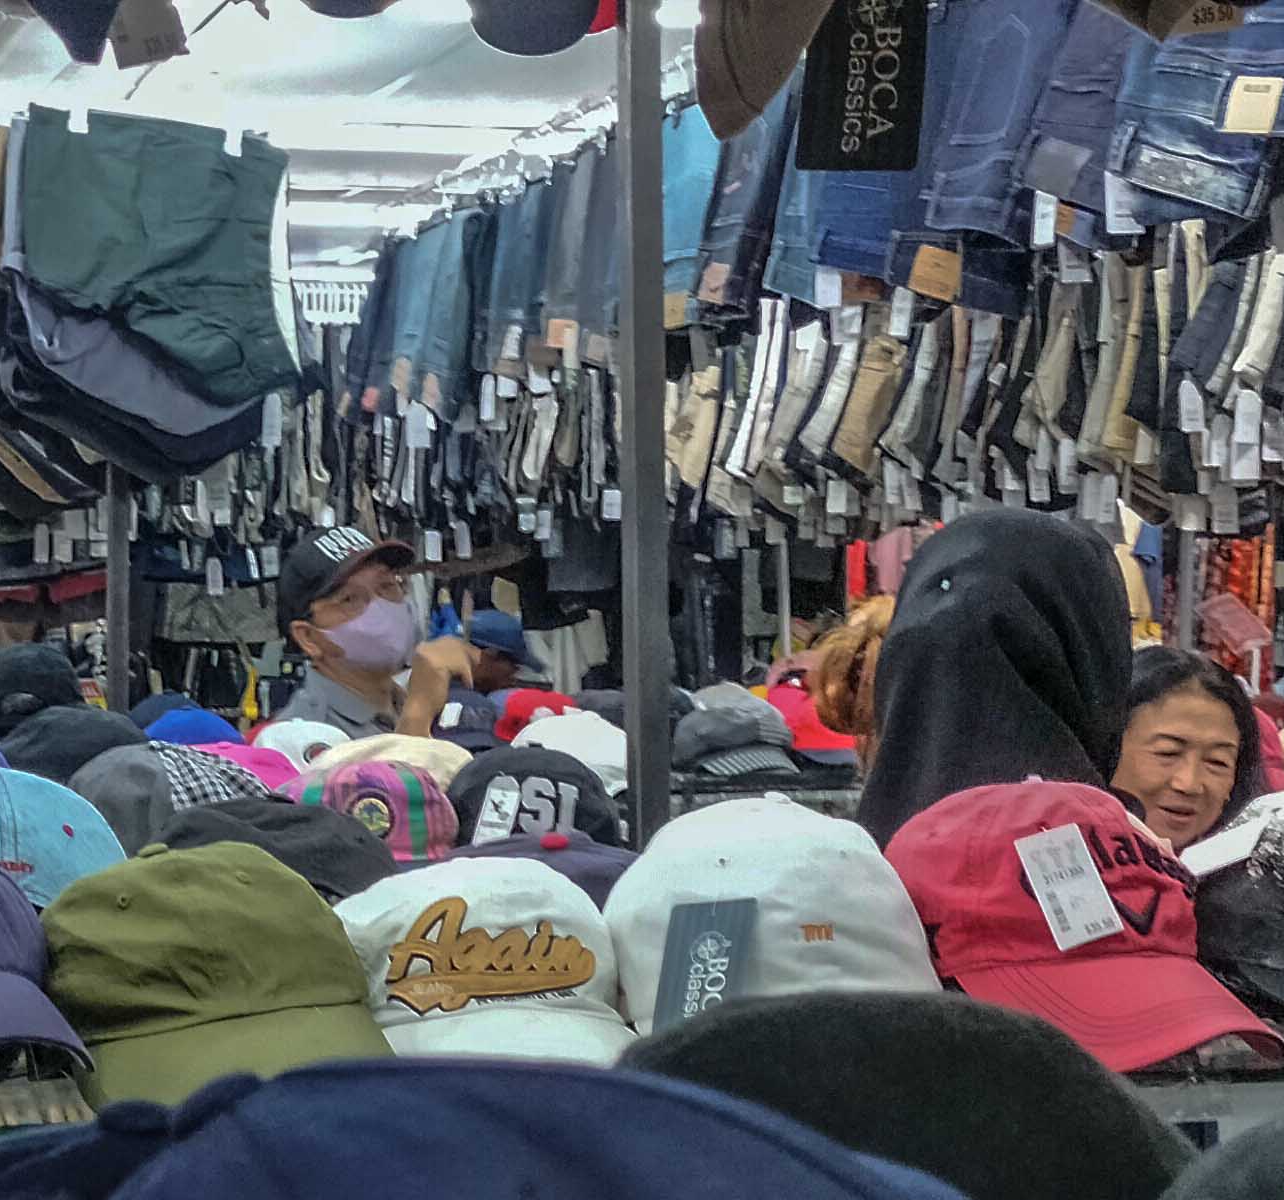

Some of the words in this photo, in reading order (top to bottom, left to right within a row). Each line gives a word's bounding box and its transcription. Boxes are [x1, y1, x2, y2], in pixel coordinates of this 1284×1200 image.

[840, 31, 873, 153] classics
[866, 26, 902, 140] BOCA
[683, 962, 707, 1019] classi
[701, 956, 730, 1012] BOC
